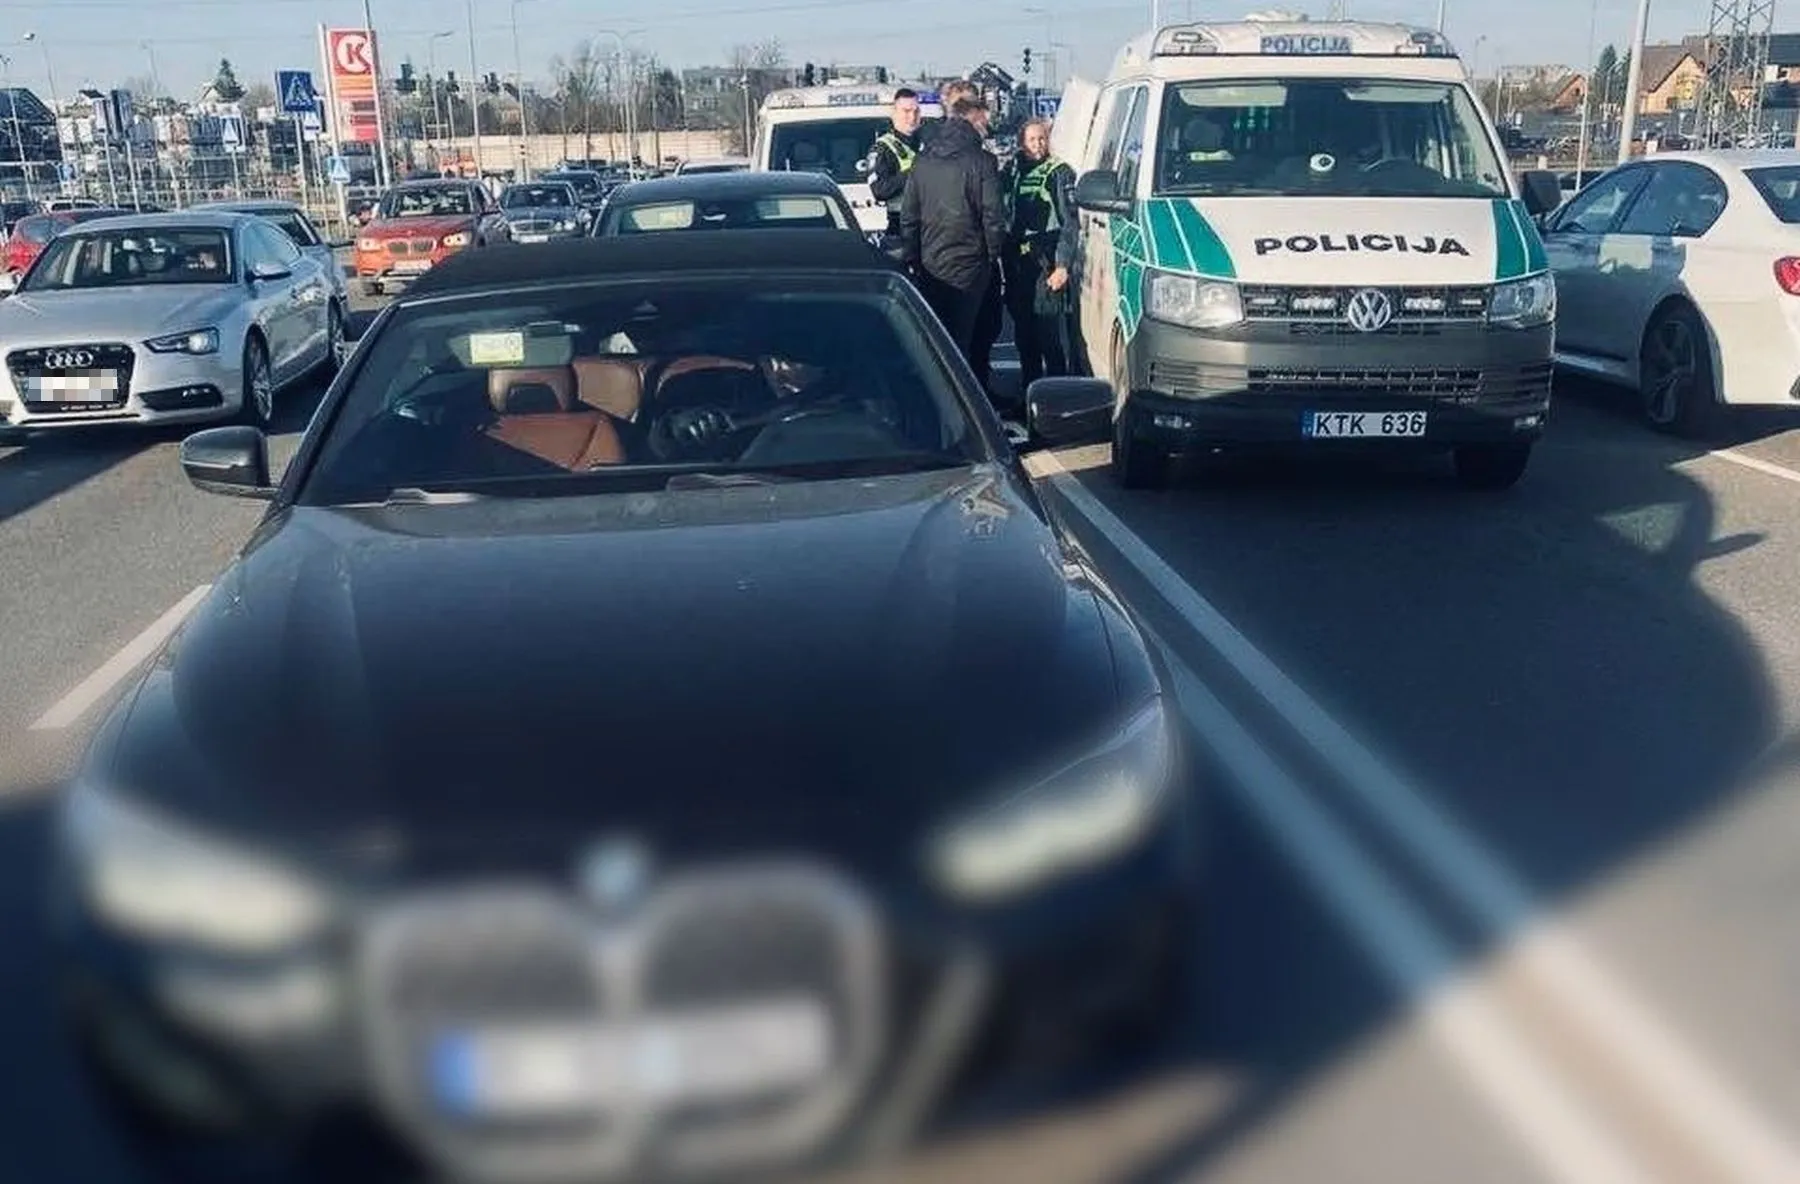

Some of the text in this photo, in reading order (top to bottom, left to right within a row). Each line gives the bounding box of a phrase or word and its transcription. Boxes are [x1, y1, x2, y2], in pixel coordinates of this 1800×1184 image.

[1261, 36, 1350, 52] POLICIJA
[1255, 234, 1470, 256] POLICIJA
[1316, 414, 1422, 434] KTK 636
